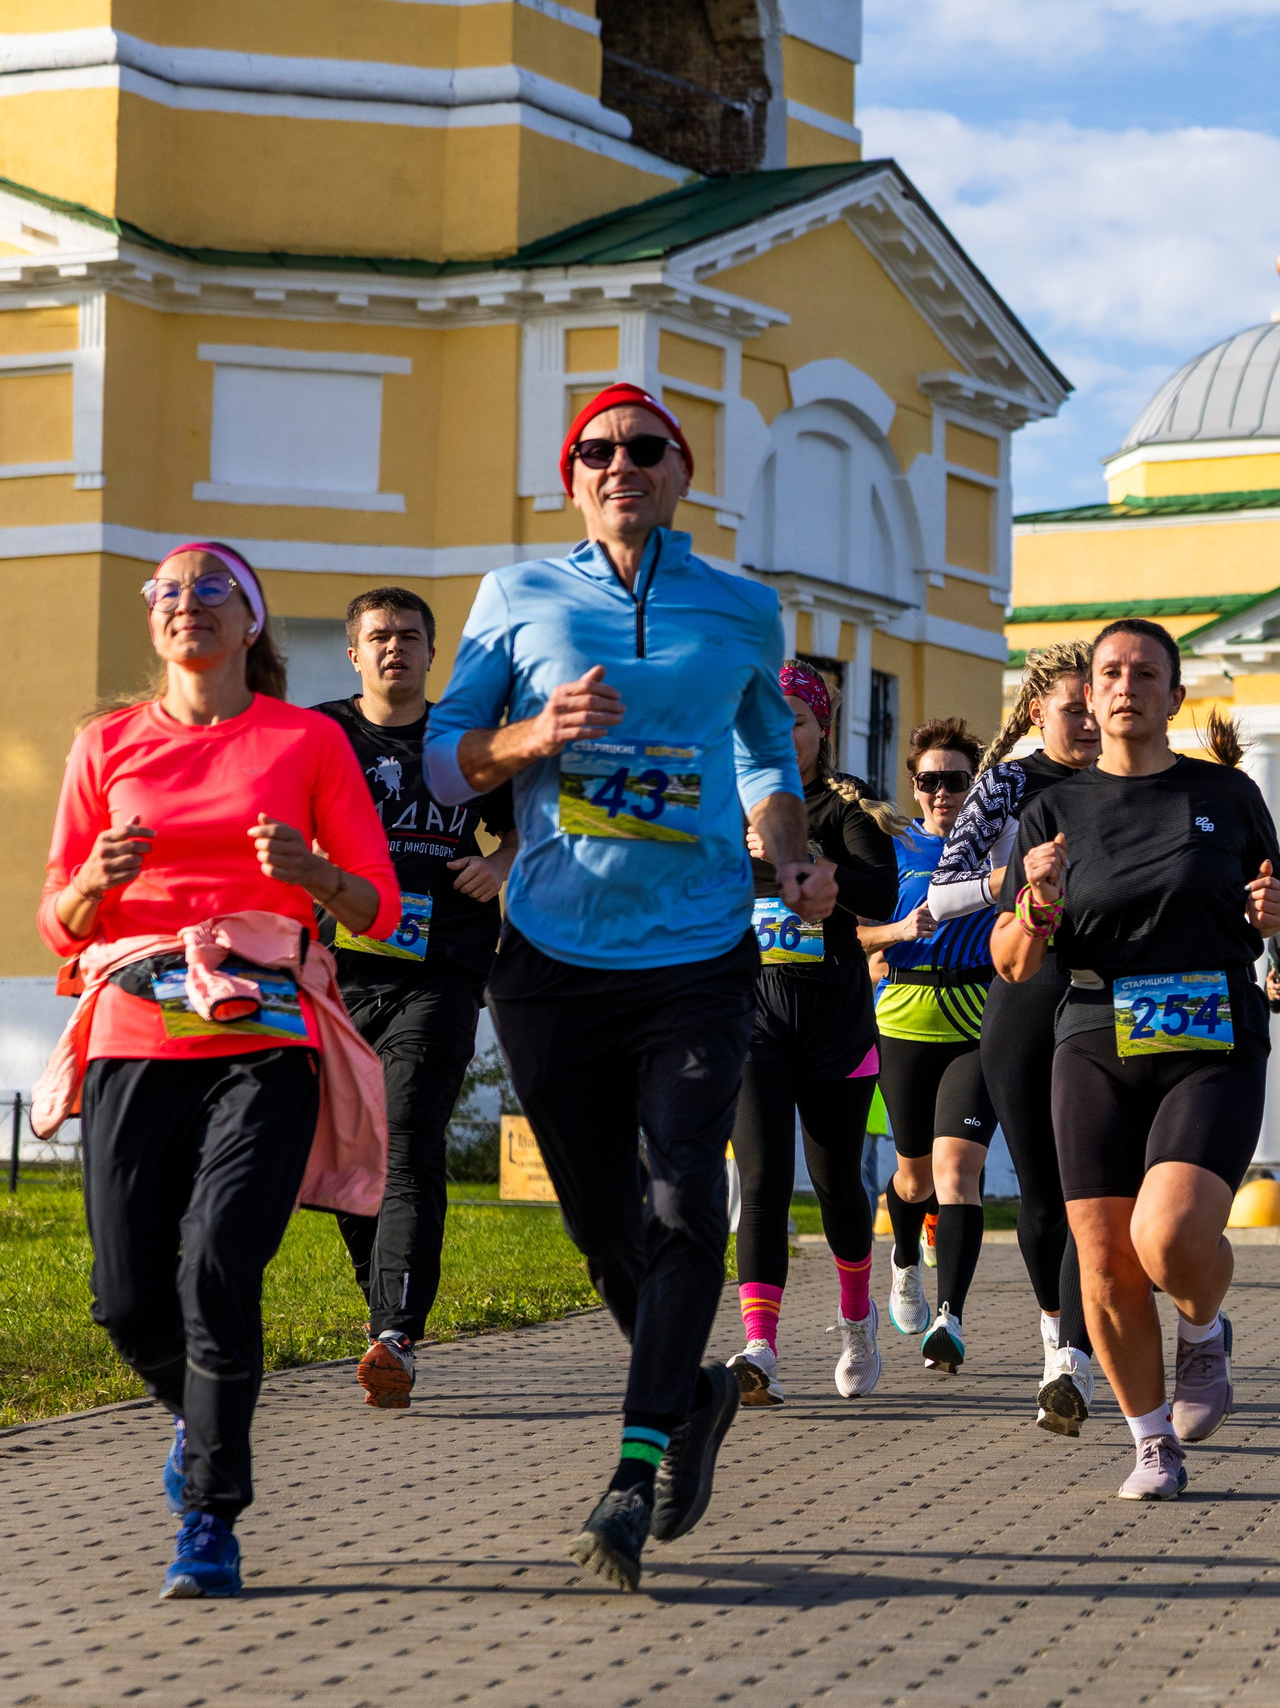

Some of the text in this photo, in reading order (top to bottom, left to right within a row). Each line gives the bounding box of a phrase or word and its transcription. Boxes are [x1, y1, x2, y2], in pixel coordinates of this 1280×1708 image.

[590, 768, 669, 821] 43
[399, 896, 428, 907] ЕРСТЫ
[758, 915, 802, 952] 56
[1121, 974, 1221, 990] СТАРИЦКИЕ ВЕРСТЫ
[1129, 993, 1221, 1040] 254
[964, 1116, 982, 1127] alo
